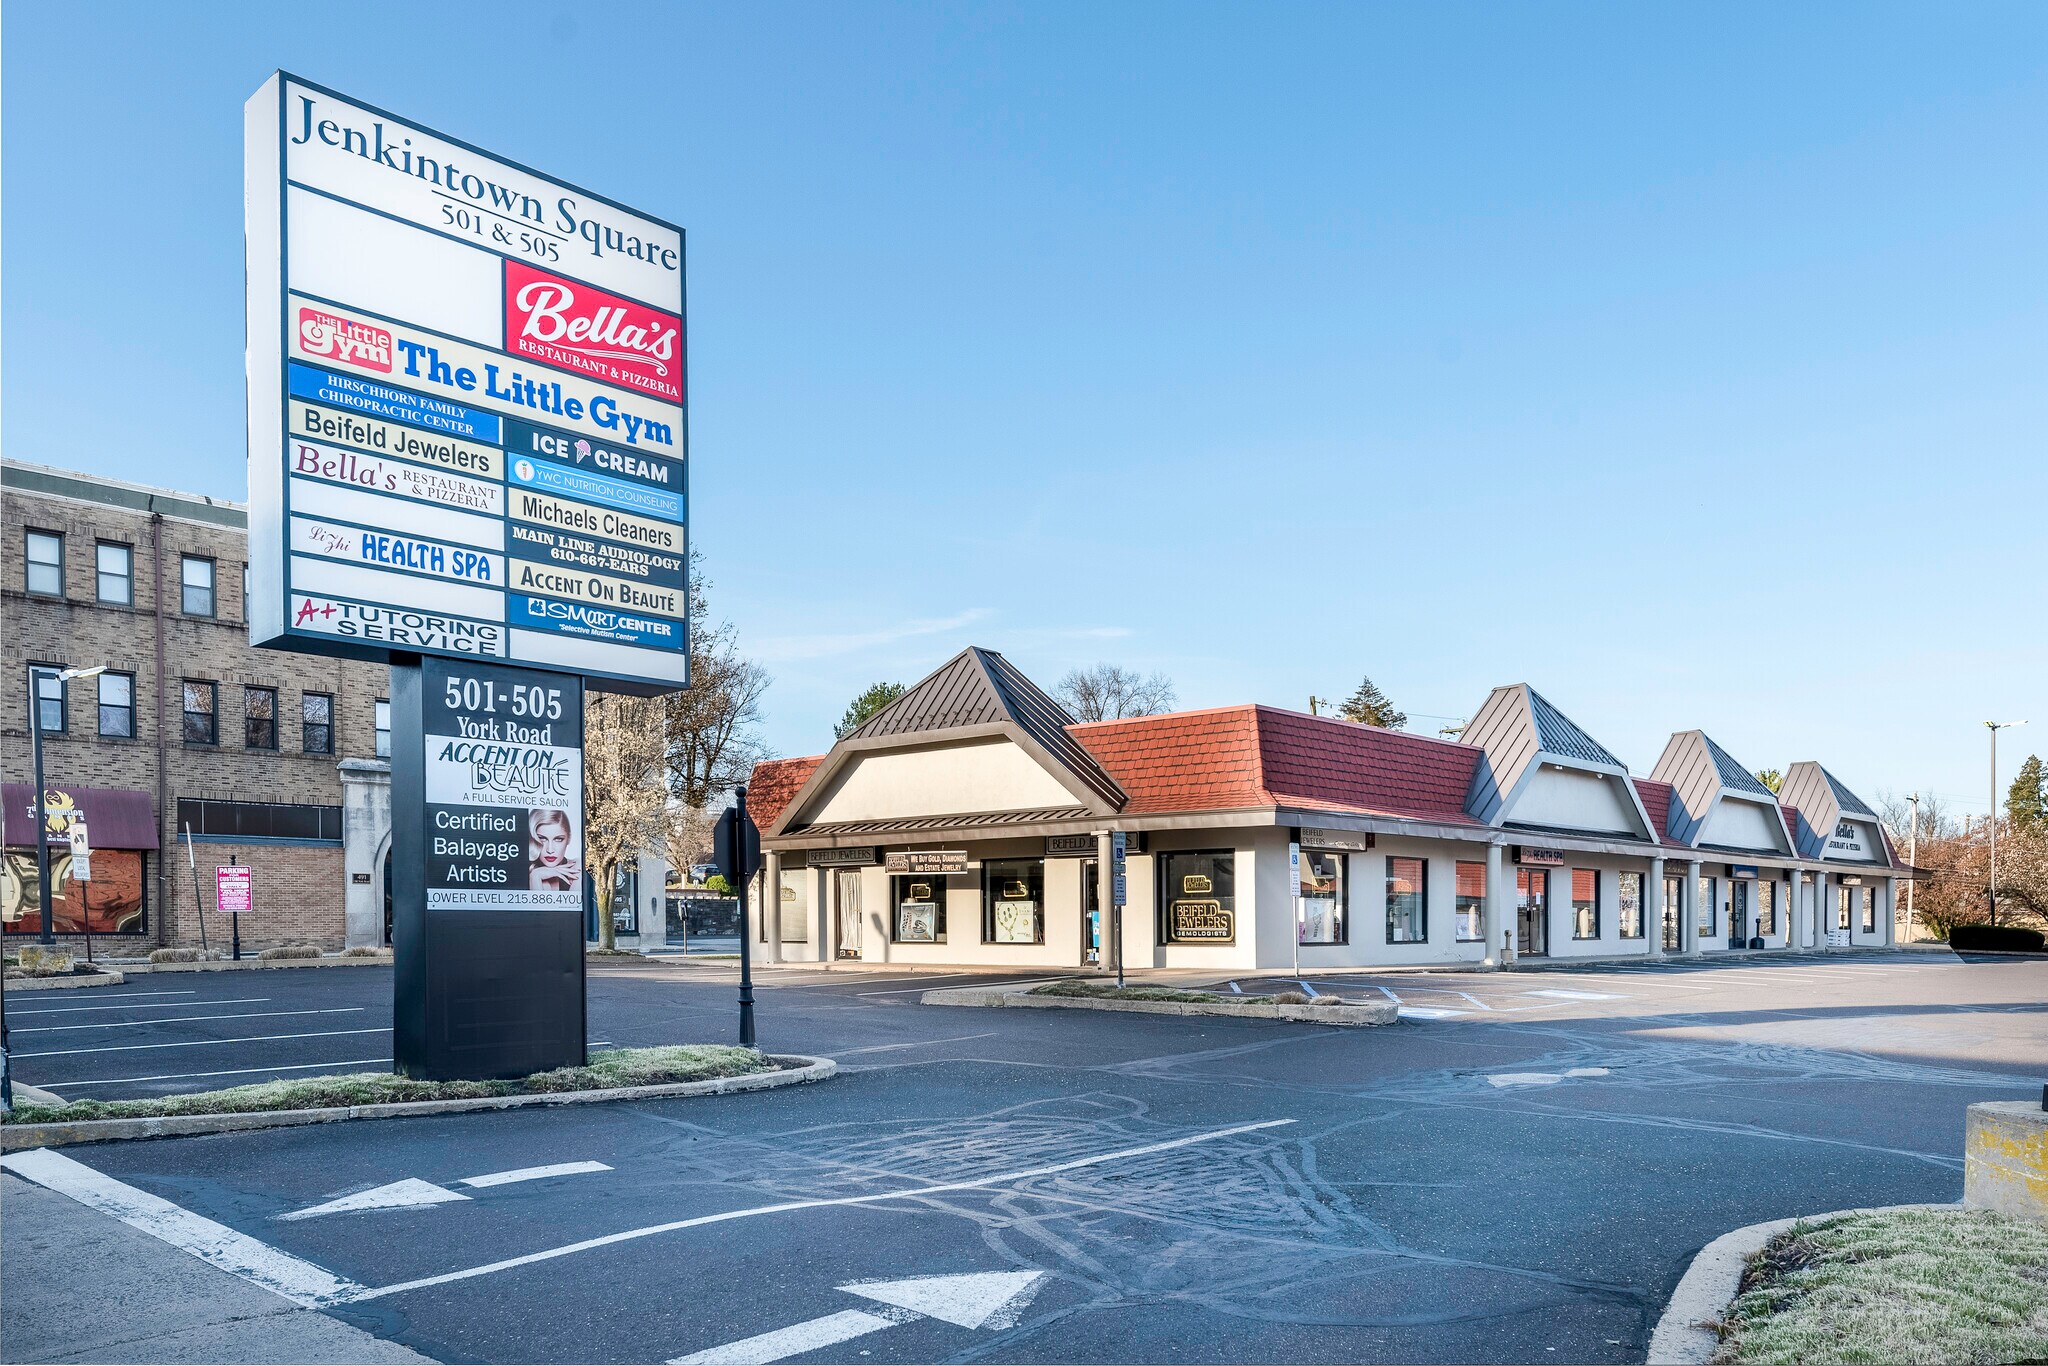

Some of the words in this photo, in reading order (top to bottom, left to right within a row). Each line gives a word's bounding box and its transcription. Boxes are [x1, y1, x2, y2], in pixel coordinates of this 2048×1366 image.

[292, 95, 543, 224] Jenkintown
[556, 197, 679, 272] Square
[441, 204, 485, 236] 501
[492, 223, 513, 246] &
[519, 232, 560, 262] 505
[314, 314, 337, 327] THE
[336, 320, 390, 349] Little
[516, 281, 677, 361] Bella's
[300, 319, 391, 365] gym
[518, 338, 608, 375] RESTAURANT
[611, 367, 619, 379] &
[621, 369, 679, 397] PIZZERIA
[327, 375, 417, 407] HIRSCHHORN
[419, 399, 467, 419] FAMILY
[397, 338, 477, 391] The
[484, 363, 584, 421] Little
[589, 395, 673, 446] Gym
[318, 388, 421, 422] CHIROPRACTIC
[423, 414, 474, 435] CENTER
[305, 408, 386, 449] Beifeld
[394, 431, 490, 472] Jewelers
[532, 432, 569, 459] ICE
[594, 449, 668, 483] CREAM
[296, 444, 397, 491] Bella's
[402, 469, 497, 500] RESTAURANT
[411, 484, 424, 496] &
[427, 487, 489, 510] PIZZERIA
[536, 469, 562, 485] YWC
[564, 477, 614, 497] NUTRITION
[616, 489, 678, 511] COUNSELING
[522, 495, 598, 531] Michaels
[603, 513, 673, 547] Cleaners
[362, 533, 445, 573] HEALTH
[452, 550, 491, 581] SPA
[512, 526, 554, 546] MAIN
[558, 535, 595, 553] LINE
[598, 542, 682, 571] AUDIOLOGY
[550, 547, 650, 577] 610-667-EARS
[295, 598, 337, 627] A+
[336, 602, 498, 641] TUTORING
[618, 616, 672, 637] CENTER
[336, 620, 497, 656] SERVICE
[445, 676, 562, 720] 501-505
[457, 716, 501, 741] York
[505, 721, 553, 746] Road
[438, 741, 522, 766] ACCENT
[522, 749, 554, 769] ON
[462, 792, 470, 802] A
[472, 793, 496, 804] FULL
[497, 795, 538, 806] SERVICE
[539, 796, 570, 808] SALON
[435, 810, 517, 832] Certified
[1302, 828, 1324, 837] BEIFELD
[434, 837, 520, 861] Balayage
[810, 852, 837, 862] BEIFELD
[838, 850, 871, 860] JEWELERS
[1052, 837, 1086, 850] BEIFELD
[446, 864, 508, 884] Artists
[427, 892, 467, 904] LOWER
[471, 893, 504, 904] LEVEL
[1176, 904, 1218, 917] BEIFELD
[1176, 916, 1228, 929] JEWELERS
